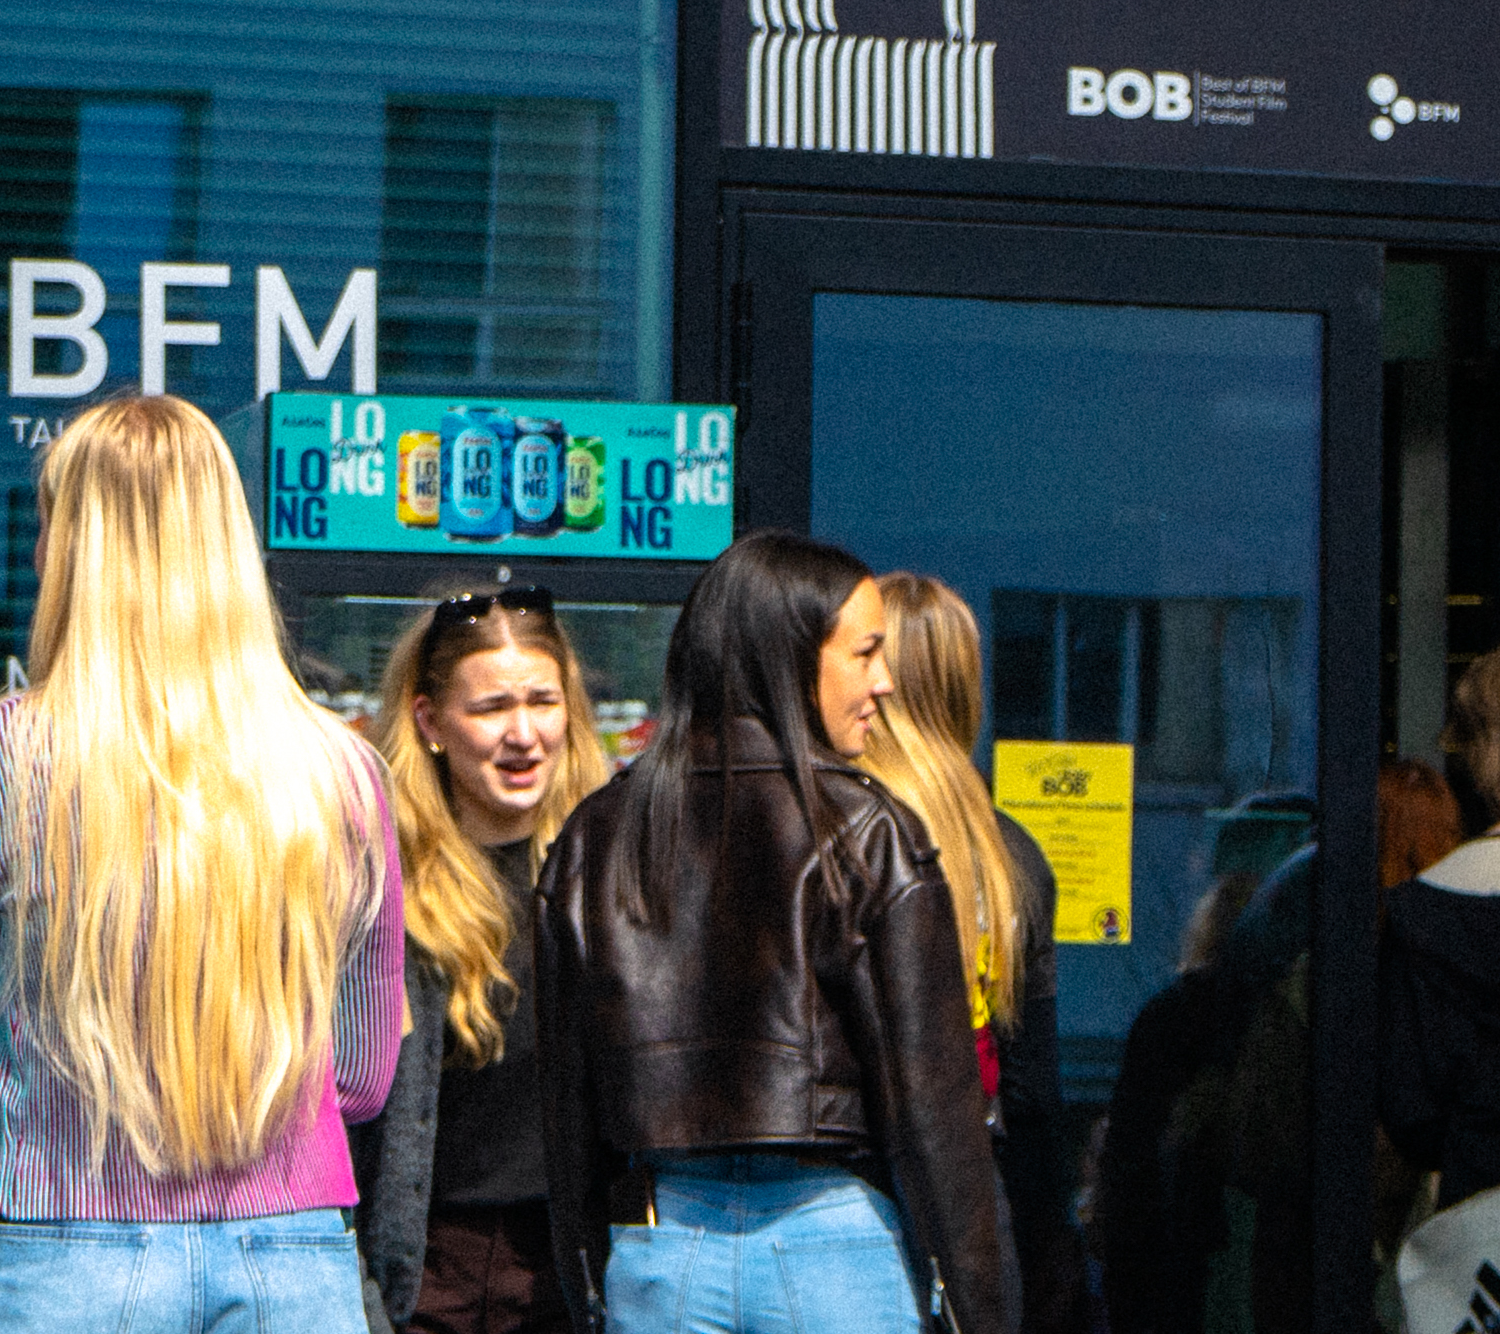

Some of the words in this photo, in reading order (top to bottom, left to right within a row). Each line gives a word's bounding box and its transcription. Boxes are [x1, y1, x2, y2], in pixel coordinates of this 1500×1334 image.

[1066, 66, 1194, 122] BOB
[1418, 101, 1460, 122] BFM
[9, 258, 378, 399] BFM
[275, 447, 329, 494] LO
[621, 458, 673, 503] LO
[274, 495, 329, 541] NG
[620, 505, 673, 549] NG
